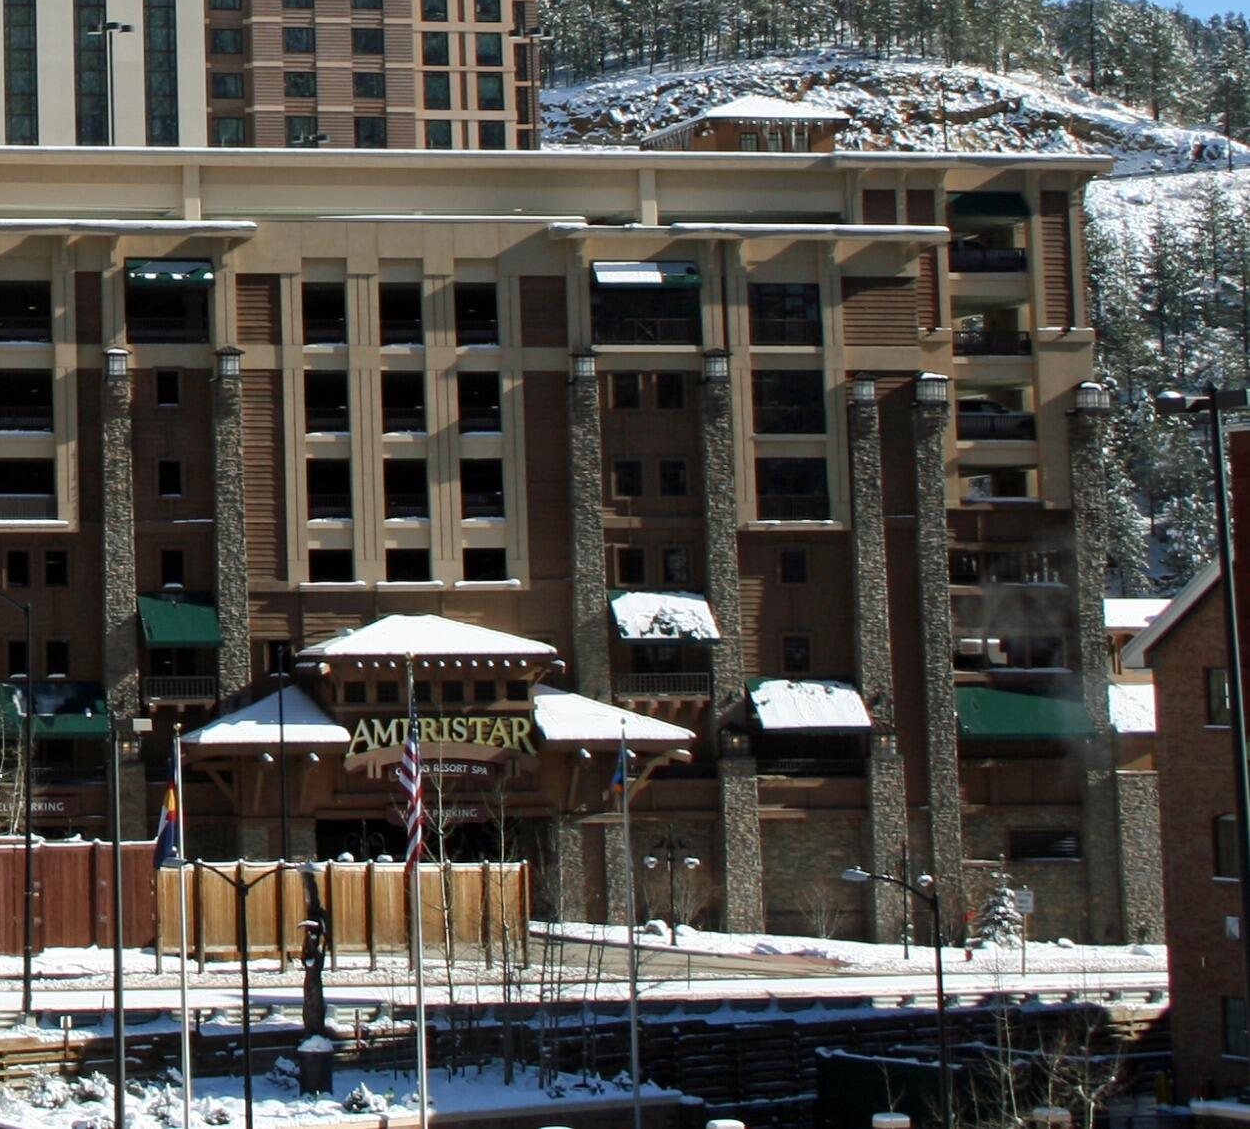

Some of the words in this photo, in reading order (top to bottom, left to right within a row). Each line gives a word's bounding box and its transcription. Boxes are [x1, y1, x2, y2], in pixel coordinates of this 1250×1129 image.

[433, 763, 467, 773] RESORT
[471, 765, 488, 775] SPA
[21, 802, 64, 812] RKING
